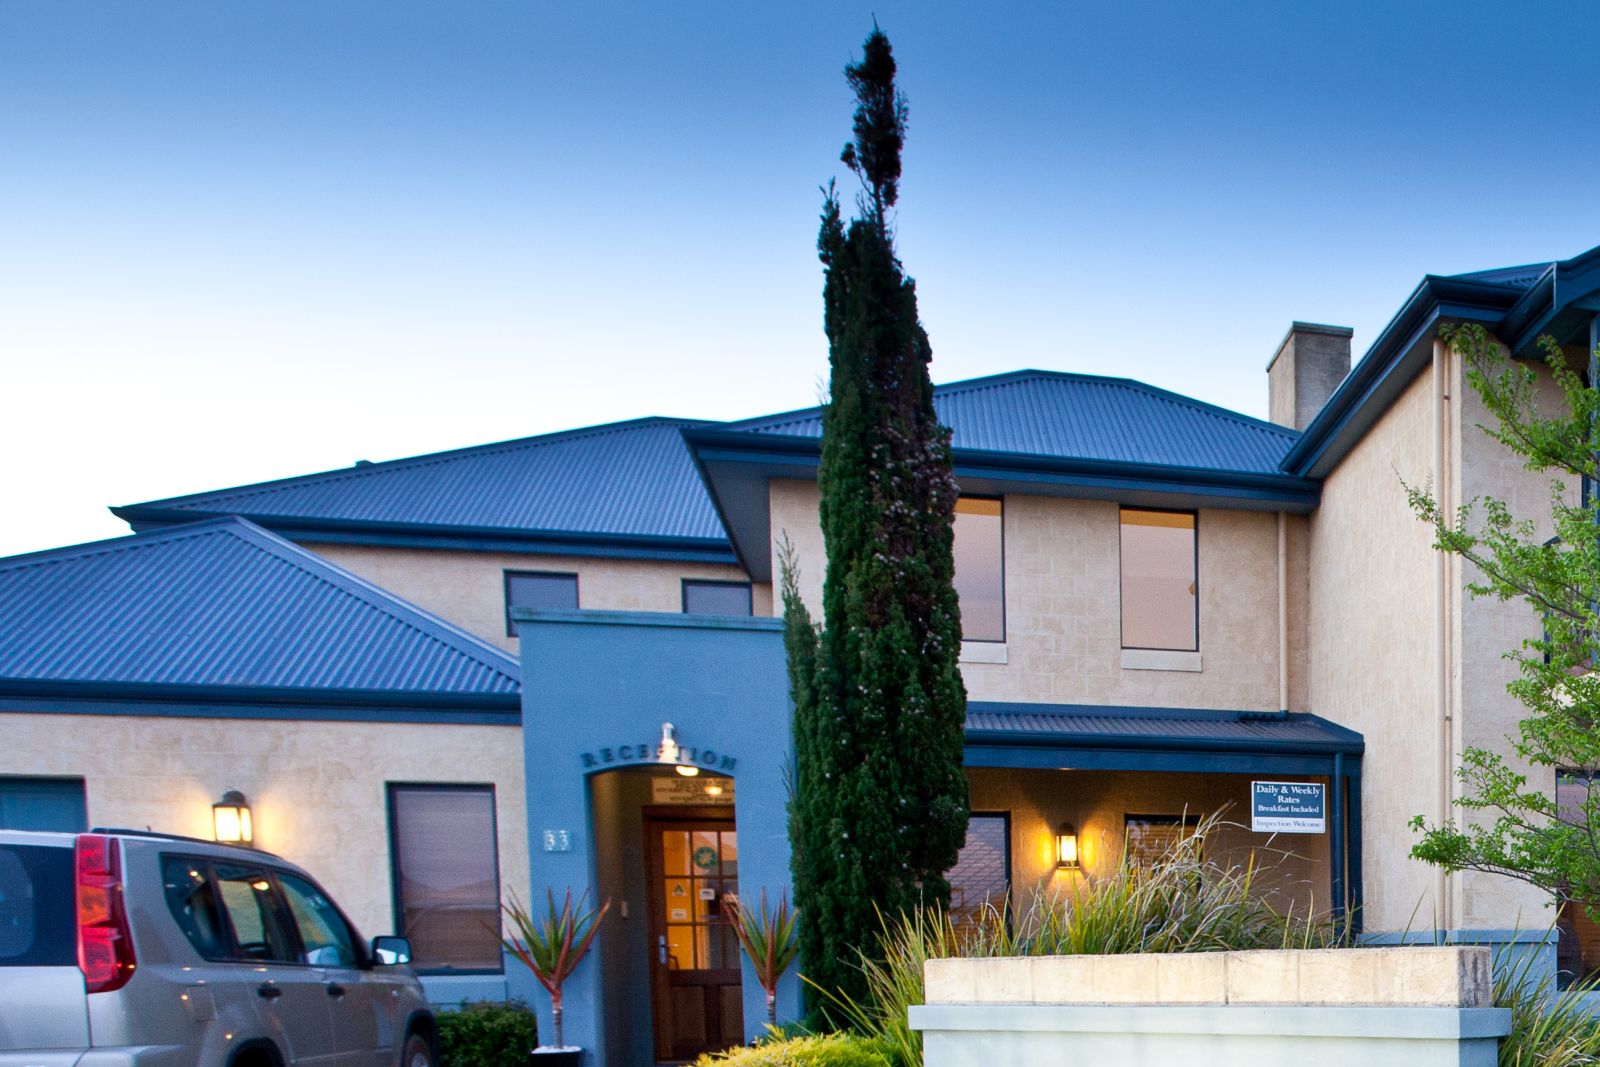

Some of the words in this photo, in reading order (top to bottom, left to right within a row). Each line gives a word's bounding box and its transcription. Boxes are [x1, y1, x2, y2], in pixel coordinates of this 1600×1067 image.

[1256, 785, 1279, 797] Daily
[1280, 786, 1289, 794] &
[1290, 786, 1321, 798] Weekly
[1277, 795, 1301, 804] Rates
[1258, 804, 1290, 813] Breakfast
[1290, 805, 1320, 814] Included
[1256, 820, 1292, 829] Inspection
[546, 832, 568, 849] 33
